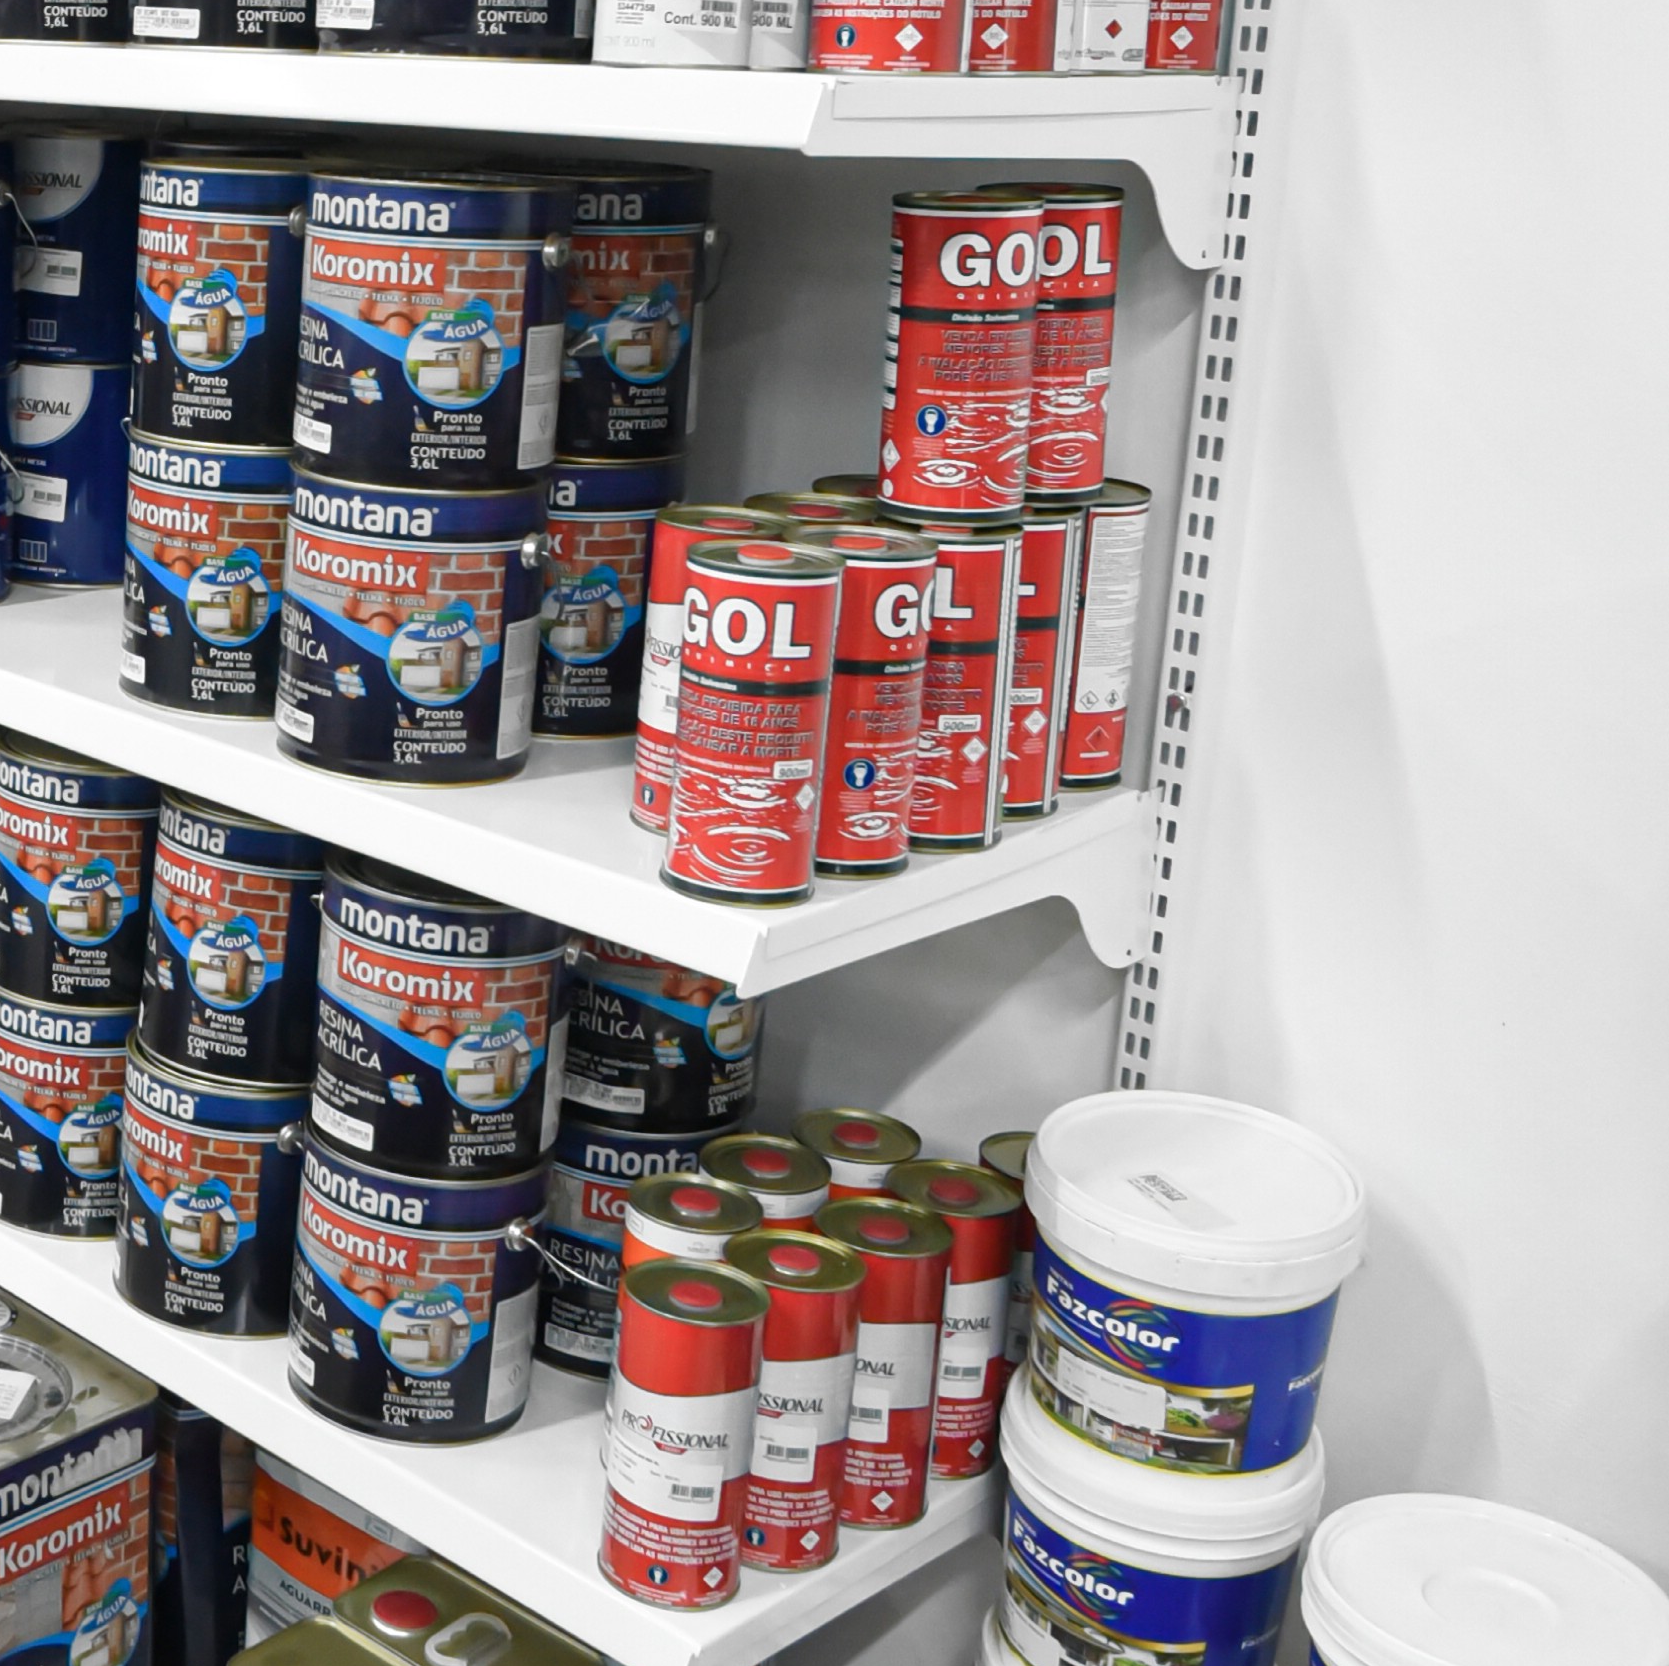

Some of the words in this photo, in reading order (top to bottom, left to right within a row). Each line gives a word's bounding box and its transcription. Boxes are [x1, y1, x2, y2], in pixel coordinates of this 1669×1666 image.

[236, 7, 306, 23] CONTEÚDO
[477, 8, 549, 24] CONTEÚDO
[477, 22, 506, 35] 3,6L
[663, 10, 697, 26] Cont.
[700, 14, 722, 28] 900
[312, 191, 450, 233] montana
[313, 244, 435, 288] Koromix
[939, 231, 1036, 288] GO
[1035, 223, 1112, 283] OL
[443, 317, 489, 340] ÁGUA
[187, 372, 229, 388] Pronto
[433, 409, 484, 426] Pronto
[410, 444, 487, 462] CONTEÚDO
[410, 457, 440, 471] 3,6L
[295, 489, 433, 536] montana
[295, 544, 418, 589] Koromix
[424, 618, 470, 640] ÁGUA
[683, 586, 812, 659] GOL
[393, 741, 468, 756] CONTEÚDO
[340, 896, 490, 953] montana
[341, 944, 475, 1001] Koromix
[318, 1000, 364, 1042] RESINA
[316, 1026, 382, 1071] ACRÍLICA
[304, 1147, 424, 1226] montana
[302, 1195, 408, 1271] Koromix
[1046, 1274, 1180, 1354] Fazcolor
[622, 1408, 730, 1450] PROFISSIONAL
[279, 1516, 379, 1586] Suvin
[1013, 1517, 1135, 1607] Fazcolor
[279, 1578, 332, 1617] AGUARR
